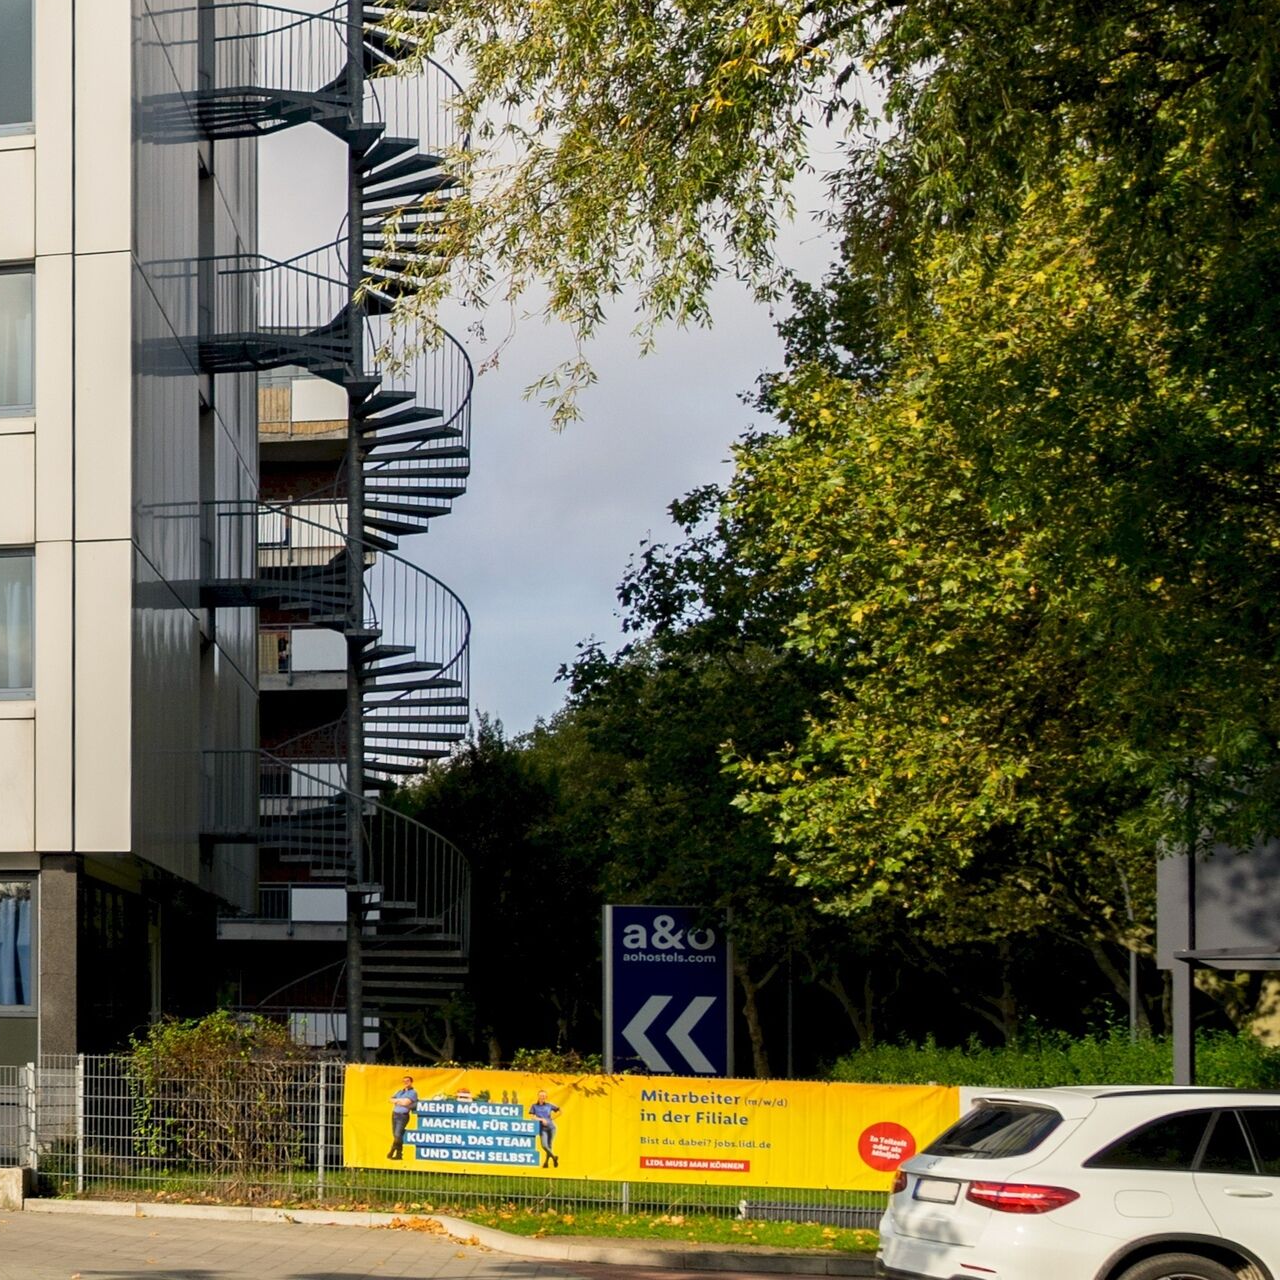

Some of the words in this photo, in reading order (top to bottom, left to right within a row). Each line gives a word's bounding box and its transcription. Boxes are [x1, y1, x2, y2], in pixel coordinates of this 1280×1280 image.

[622, 914, 716, 951] a&o
[622, 952, 717, 963] aohostels.com
[641, 1089, 741, 1105] Mitarbeiter
[744, 1097, 788, 1108] (m/w/d)
[416, 1101, 454, 1114] MEHR
[456, 1103, 519, 1116] MÖGLICH
[422, 1117, 480, 1130] MACHEN.
[482, 1119, 508, 1131] FÜR
[511, 1122, 535, 1133] DIE
[640, 1109, 656, 1122] in
[662, 1110, 690, 1124] der
[696, 1111, 749, 1126] Filiale
[406, 1132, 465, 1146] KUNDEN,
[468, 1135, 494, 1146] DAS
[496, 1137, 532, 1148] TEAM
[640, 1136, 659, 1145] Bist
[662, 1137, 675, 1145] du
[678, 1138, 711, 1147] dabei?
[714, 1139, 771, 1149] jobs.lidl.de
[420, 1148, 449, 1159] UND
[451, 1150, 486, 1161] DICH
[487, 1151, 536, 1164] SELBST.
[645, 1159, 664, 1167] LIDL
[665, 1160, 688, 1168] MUSS
[689, 1160, 708, 1169] MAN
[709, 1160, 745, 1170] KÖNNEN
